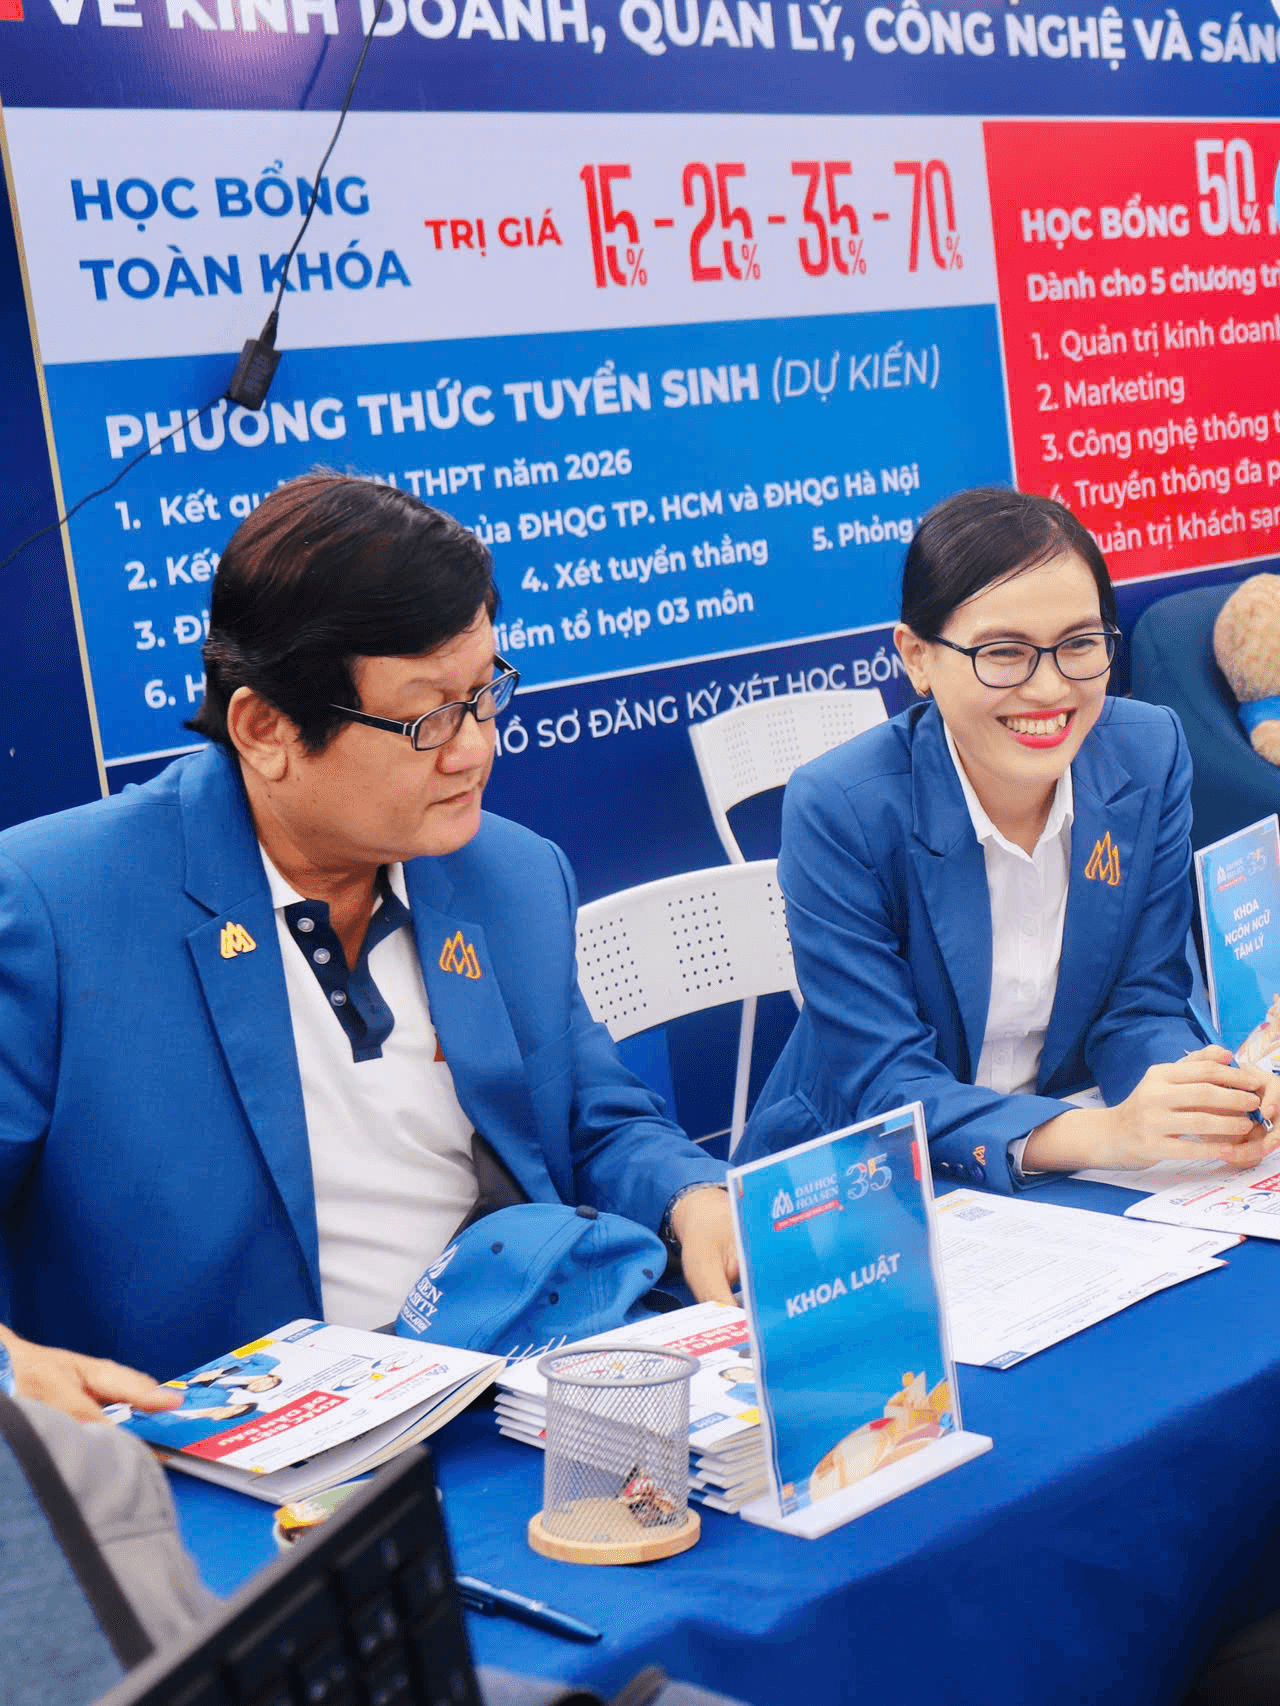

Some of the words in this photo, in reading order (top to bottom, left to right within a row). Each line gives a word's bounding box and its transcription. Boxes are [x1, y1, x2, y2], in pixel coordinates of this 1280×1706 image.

[360, 0, 607, 54] DOANH,
[864, 0, 996, 57] CÔNG
[1005, 4, 1127, 70] NGHỆ
[1132, 2, 1193, 61] VÀ
[71, 176, 199, 231] HỌC
[214, 159, 371, 219] BỔNG
[1021, 206, 1091, 251] HỌC
[1100, 194, 1190, 240] BỔNG
[1194, 138, 1262, 236] 50%
[424, 217, 487, 257] TRỊ
[498, 208, 563, 248] GIÁ
[579, 163, 648, 289] 15%
[682, 162, 762, 282] 25%
[791, 160, 867, 276] 35%
[894, 159, 963, 273] 70%
[79, 244, 242, 300] TOÀN
[261, 239, 412, 292] KHÓA
[1027, 270, 1097, 303] Dành
[1100, 267, 1147, 297] cho
[1150, 267, 1167, 295] 5
[1169, 263, 1258, 296] chương
[1031, 332, 1050, 360] 1.
[1060, 324, 1128, 362] Quản
[1132, 321, 1160, 357] trị
[1163, 316, 1215, 350] kinh
[105, 397, 347, 459] PHƯƠNG
[358, 379, 495, 435] THỨC
[504, 360, 650, 421] TUYỂN
[660, 362, 761, 409] SINH
[772, 351, 842, 404] (DỰ
[848, 340, 942, 393] KIẾN)
[1036, 383, 1059, 412] 2.
[1063, 372, 1185, 409] Marketing
[1041, 433, 1064, 462] 3.
[1067, 430, 1132, 462] Công
[1137, 417, 1198, 456] nghệ
[1203, 414, 1270, 442] thông
[405, 464, 486, 498] THPT
[494, 457, 559, 489] năm
[564, 449, 633, 480] 2026
[1073, 472, 1157, 511] Truyền
[1161, 464, 1230, 497] thông
[1235, 456, 1263, 485] đa
[114, 501, 141, 531] 1.
[160, 488, 222, 526] Kết
[517, 502, 607, 542] ĐHQG
[612, 499, 656, 530] TP.
[660, 489, 724, 522] HCM
[728, 484, 760, 513] và
[763, 473, 841, 510] ĐHQG
[844, 470, 878, 499] Hà
[881, 463, 921, 497] Nội
[1147, 516, 1173, 549] trị
[1178, 505, 1246, 541] khách
[812, 528, 834, 552] 5.
[837, 514, 914, 549] Phỏng
[124, 560, 157, 591] 2.
[521, 566, 549, 593] 4.
[555, 552, 605, 590] Xét
[607, 543, 688, 583] tuyển
[691, 534, 770, 569] thẳng
[133, 620, 166, 651] 3.
[561, 606, 592, 640] tổ
[597, 600, 652, 637] hợp
[657, 598, 692, 626] 03
[696, 590, 755, 620] môn
[144, 679, 176, 710] 6.
[538, 712, 582, 750] SƠ
[588, 698, 680, 741] ĐĂNG
[685, 680, 724, 719] KÝ
[728, 668, 780, 712] XÉT
[786, 660, 846, 701] HỌC
[1224, 922, 1251, 947] NGÔN
[1252, 908, 1272, 931] NGỮ
[1233, 898, 1260, 922] KHOA
[1233, 939, 1254, 961] TÂM
[1254, 930, 1266, 951] LÝ
[845, 1152, 894, 1201] 35
[785, 1279, 848, 1320] KHOA
[850, 1252, 902, 1298] LUẬT
